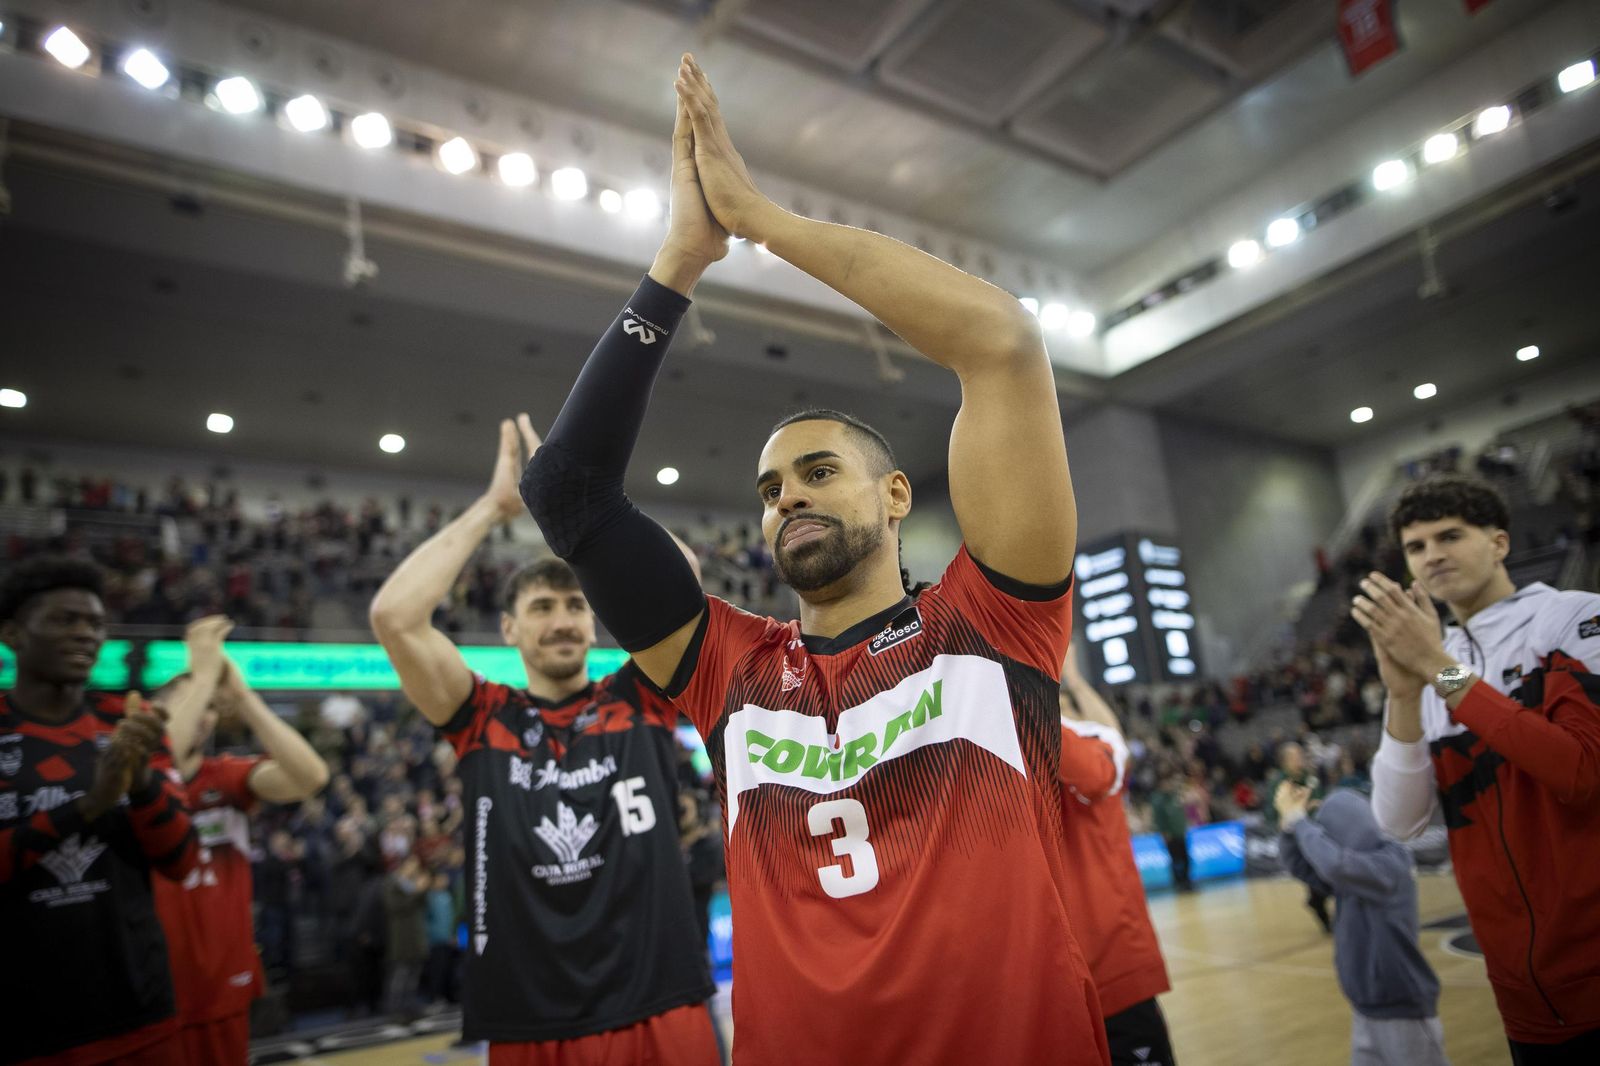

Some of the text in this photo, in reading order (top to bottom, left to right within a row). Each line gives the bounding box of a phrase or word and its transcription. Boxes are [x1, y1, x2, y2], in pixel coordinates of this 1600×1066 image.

[873, 621, 919, 648] endesa
[610, 776, 656, 837] 15
[807, 798, 880, 899] 3
